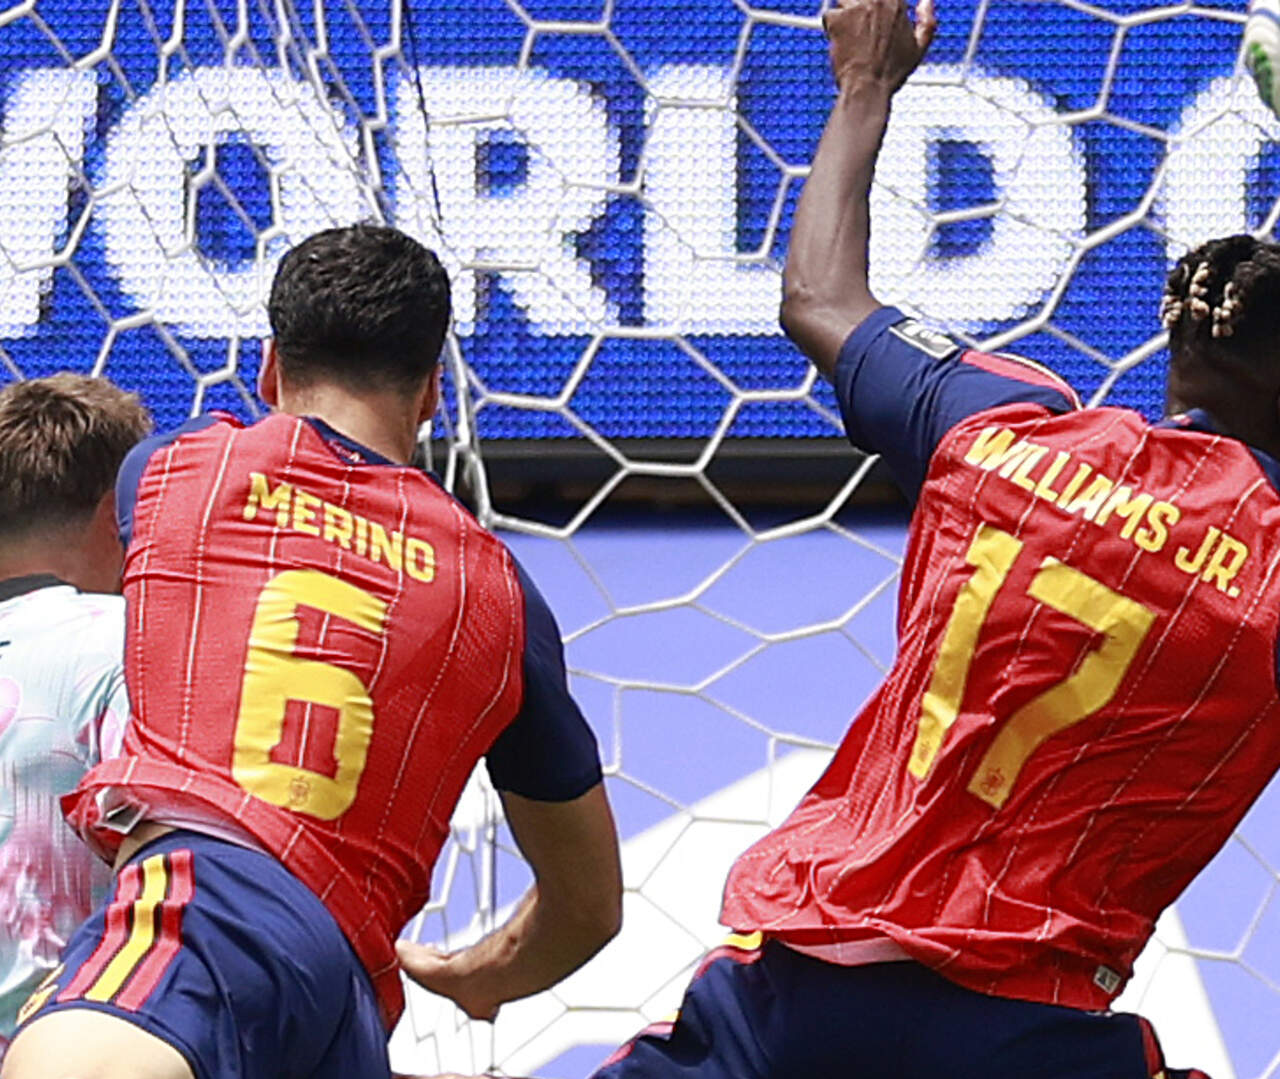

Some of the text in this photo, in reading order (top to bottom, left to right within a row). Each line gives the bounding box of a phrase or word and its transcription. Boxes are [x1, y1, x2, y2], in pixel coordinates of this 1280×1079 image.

[242, 471, 436, 583] MERINO
[964, 426, 1253, 597] WILLIAMS JR.
[232, 568, 390, 821] 6
[908, 522, 1157, 810] 17
